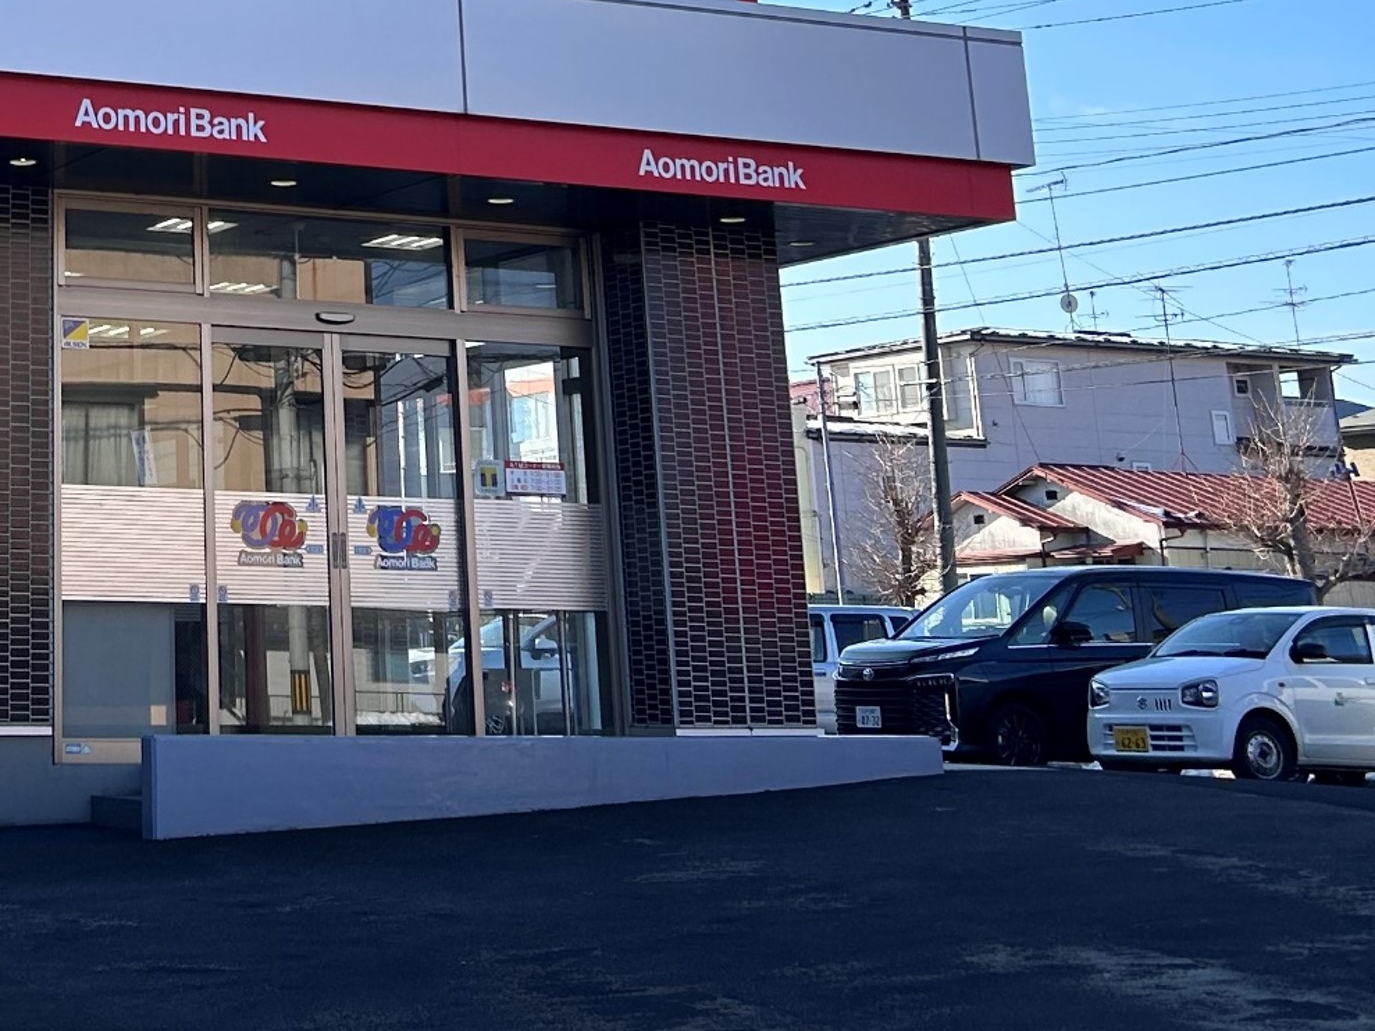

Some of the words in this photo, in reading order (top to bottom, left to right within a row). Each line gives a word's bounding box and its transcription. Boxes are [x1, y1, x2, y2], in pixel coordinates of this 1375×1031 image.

[75, 98, 185, 136] Aomori
[189, 107, 267, 143] Bank
[639, 148, 735, 184] Aomori
[737, 157, 807, 190] Bank
[240, 552, 275, 565] Aomori
[276, 553, 302, 566] Bank
[377, 556, 410, 568] Aomori
